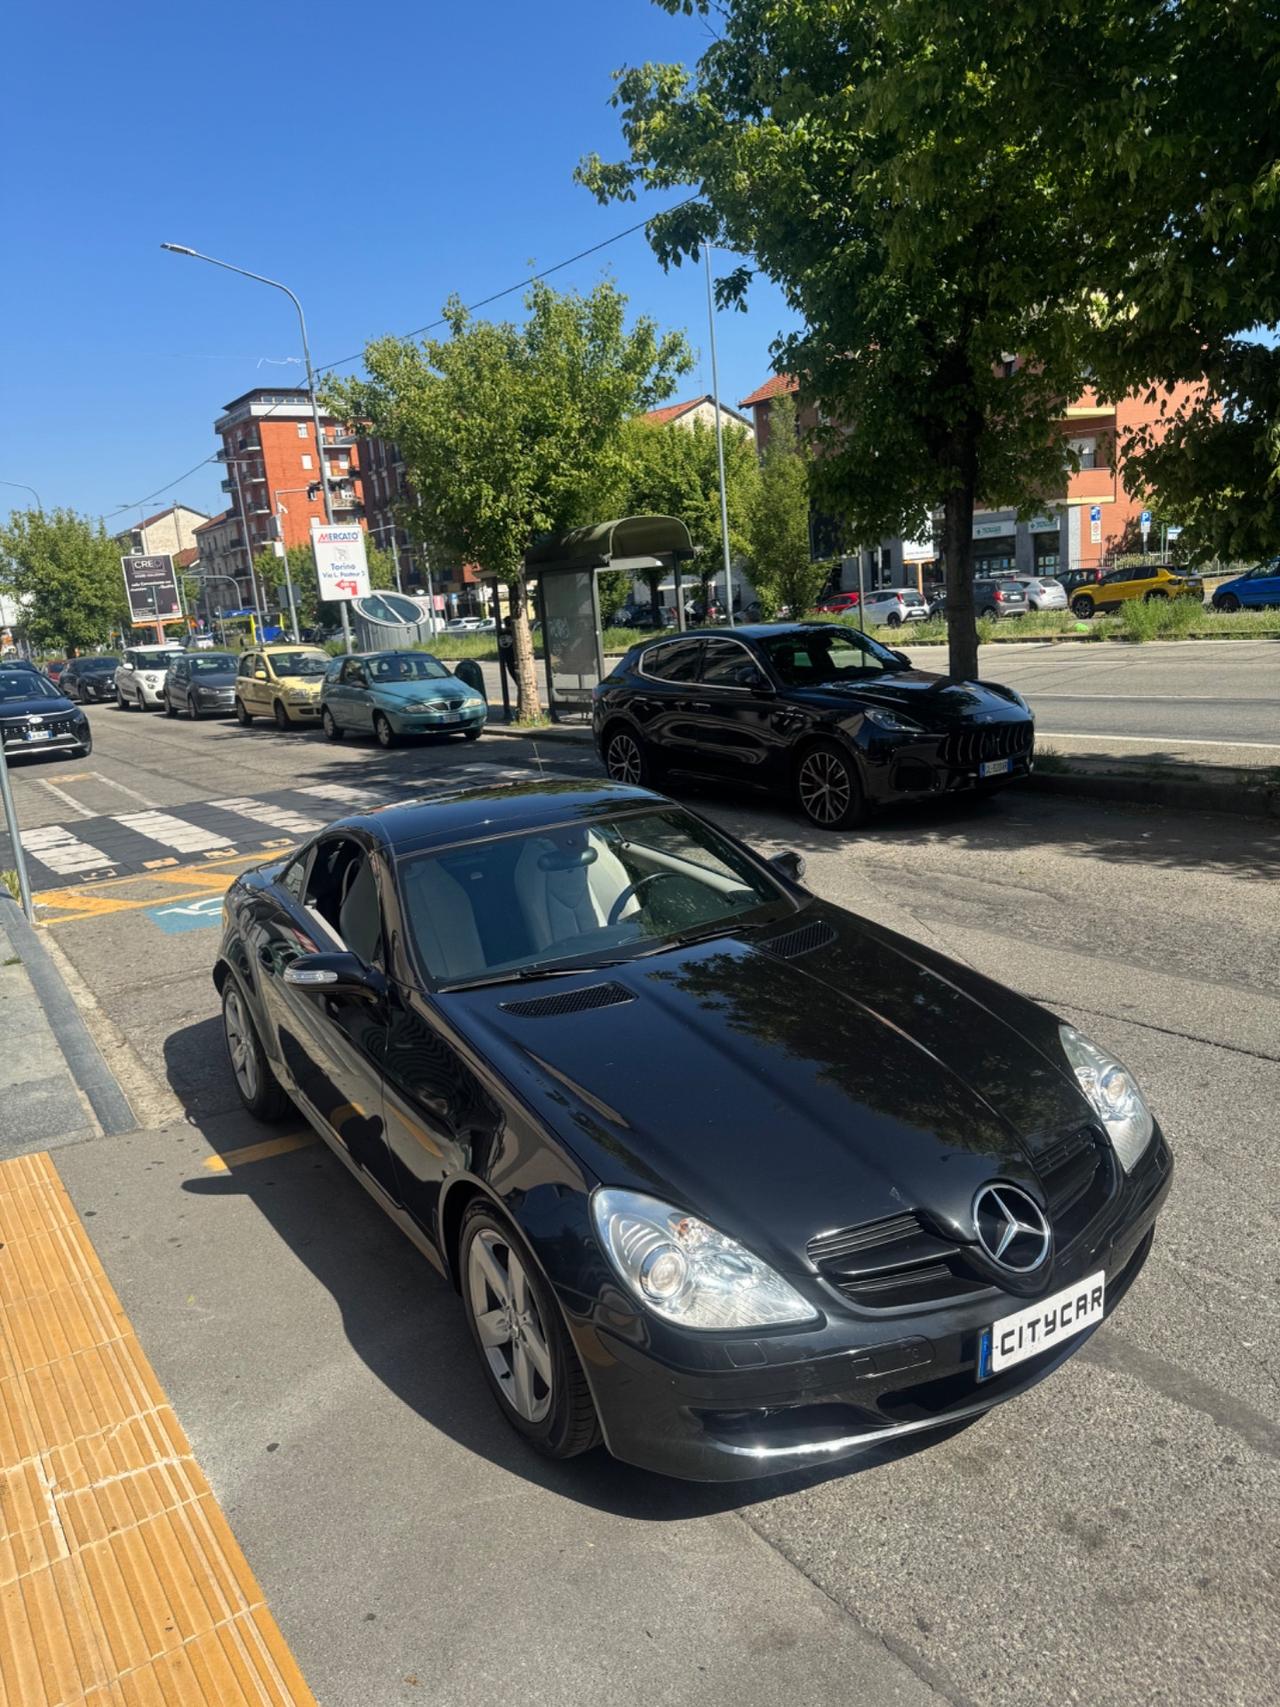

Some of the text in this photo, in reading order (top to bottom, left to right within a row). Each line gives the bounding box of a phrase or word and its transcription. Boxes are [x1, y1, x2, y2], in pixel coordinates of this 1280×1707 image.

[134, 559, 162, 569] CREO
[330, 562, 356, 570] Torino
[1001, 1286, 1103, 1357] CITYCAR
